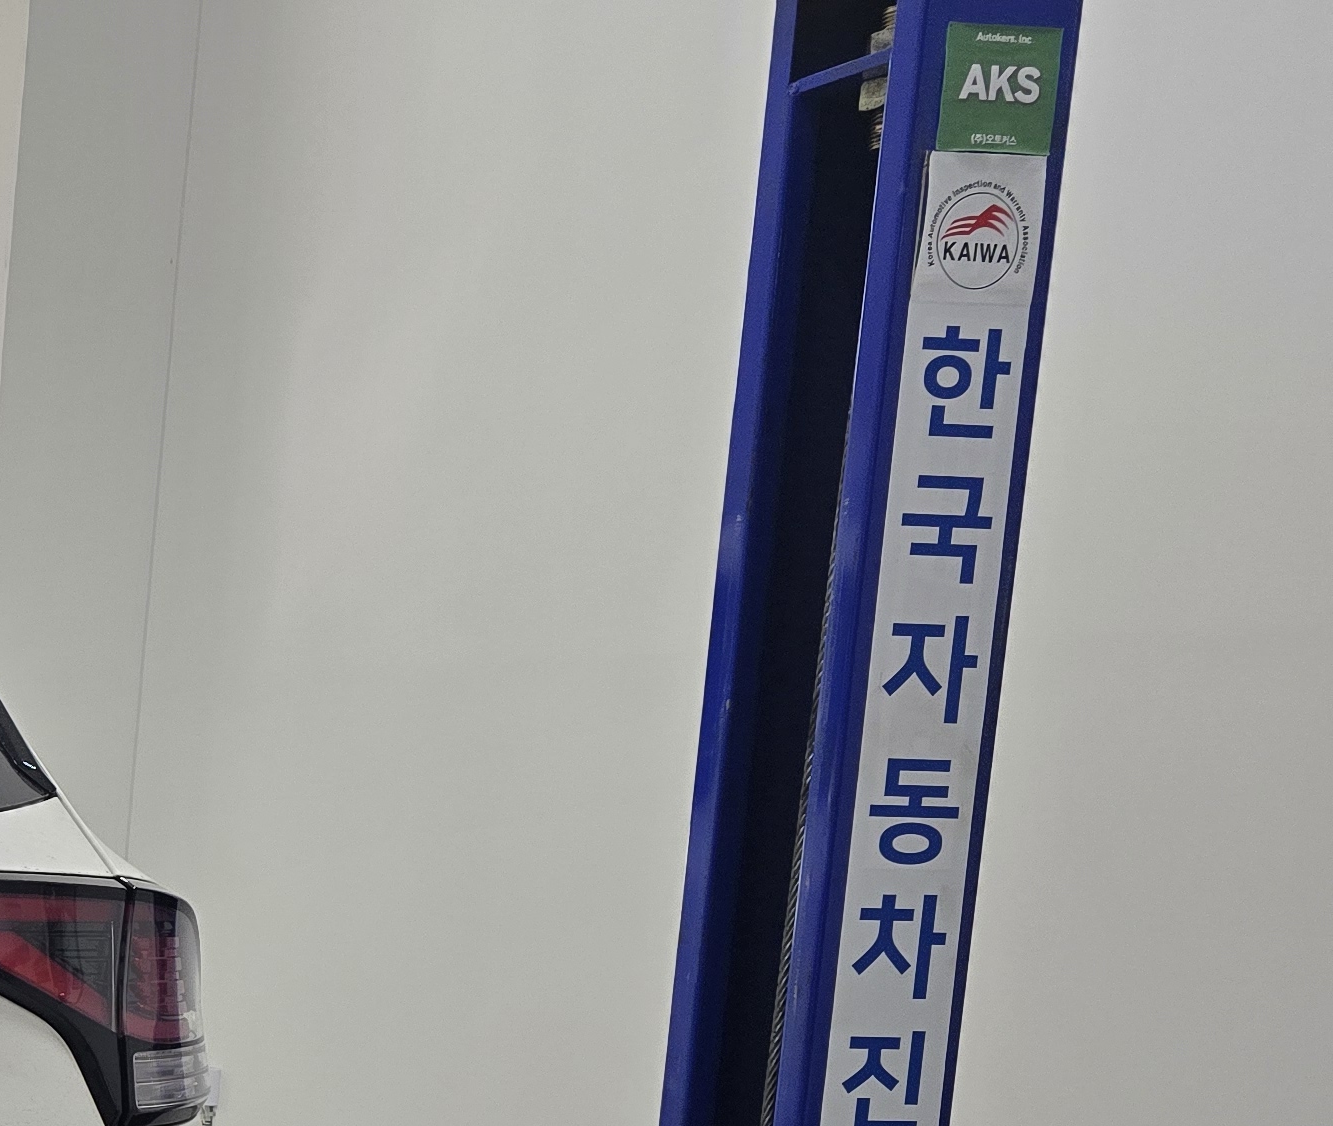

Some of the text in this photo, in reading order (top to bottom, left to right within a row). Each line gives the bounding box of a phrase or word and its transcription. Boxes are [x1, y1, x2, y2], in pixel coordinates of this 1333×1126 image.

[958, 63, 1041, 104] AKS
[927, 180, 1029, 274] Korea Automotive Inspection and Warranty Association
[942, 241, 1010, 263] KAIWA
